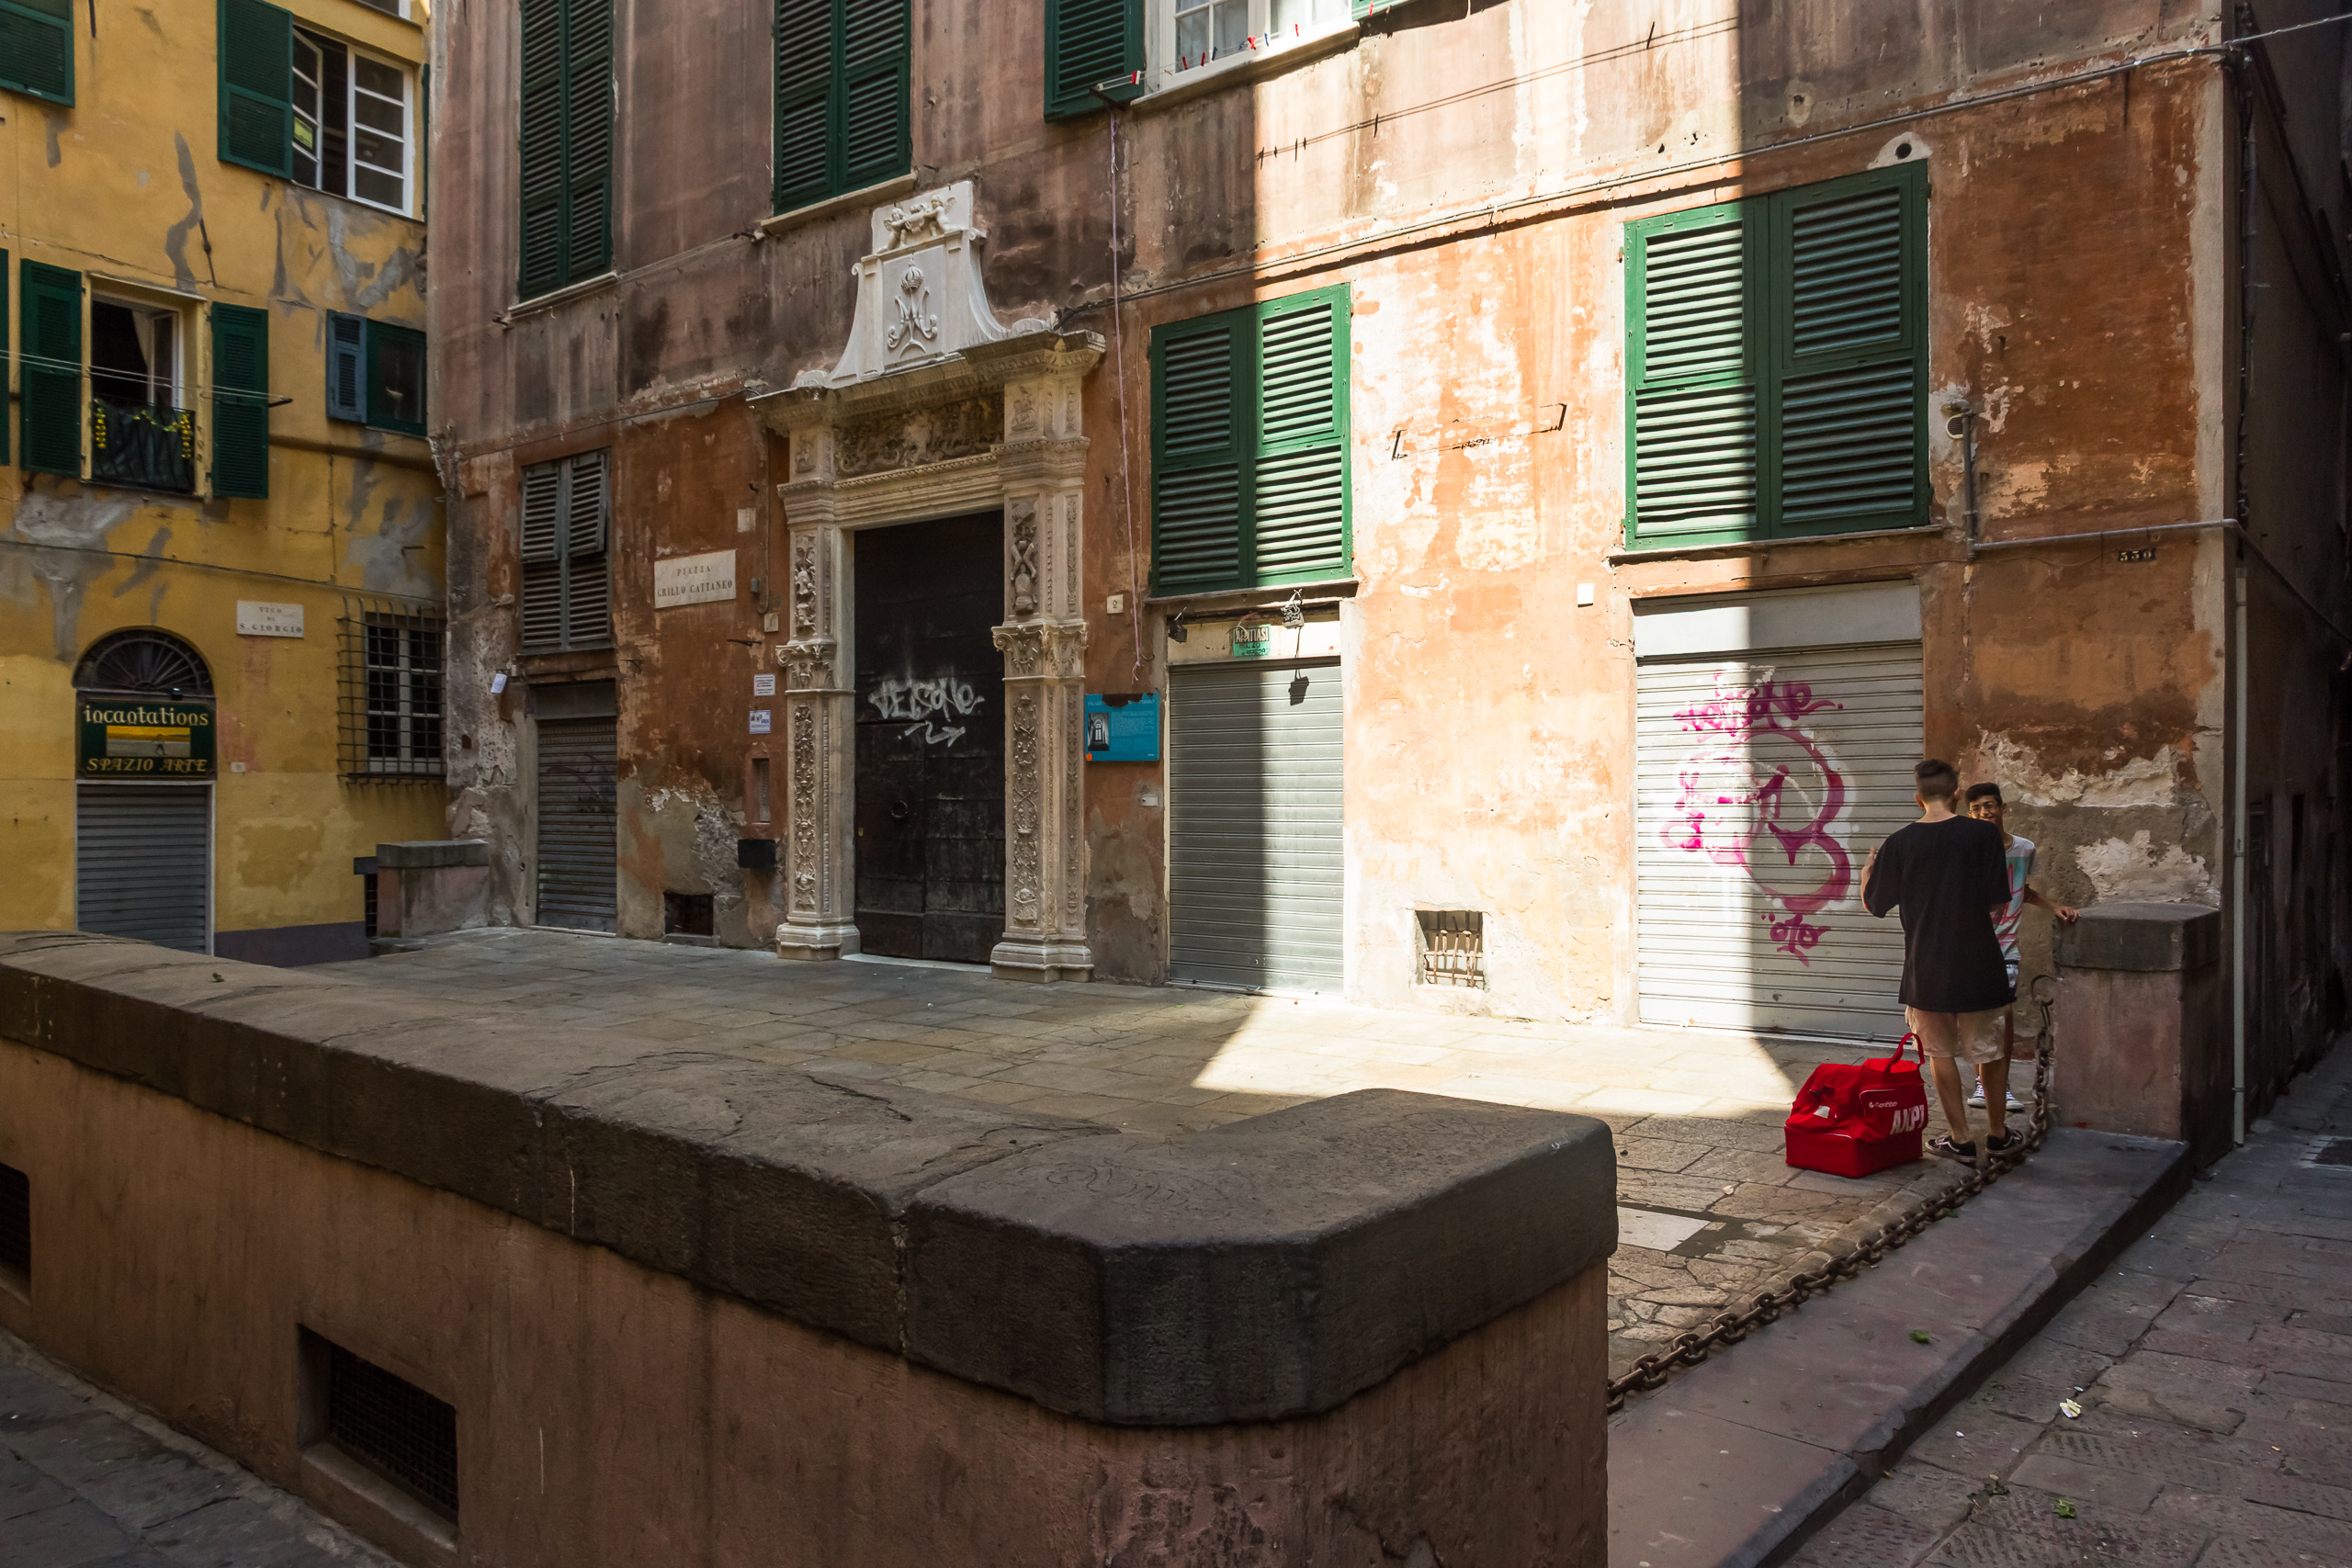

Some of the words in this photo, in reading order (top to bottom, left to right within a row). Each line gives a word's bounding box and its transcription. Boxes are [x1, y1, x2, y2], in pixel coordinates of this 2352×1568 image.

[677, 565, 710, 577] PIAZZA
[657, 585, 686, 598] GRILLO
[690, 579, 732, 593] CATTANEO
[252, 624, 302, 633] GIORGIO
[84, 705, 209, 727] incantations
[87, 758, 154, 772] SPAZIO
[160, 759, 208, 773] ARTE
